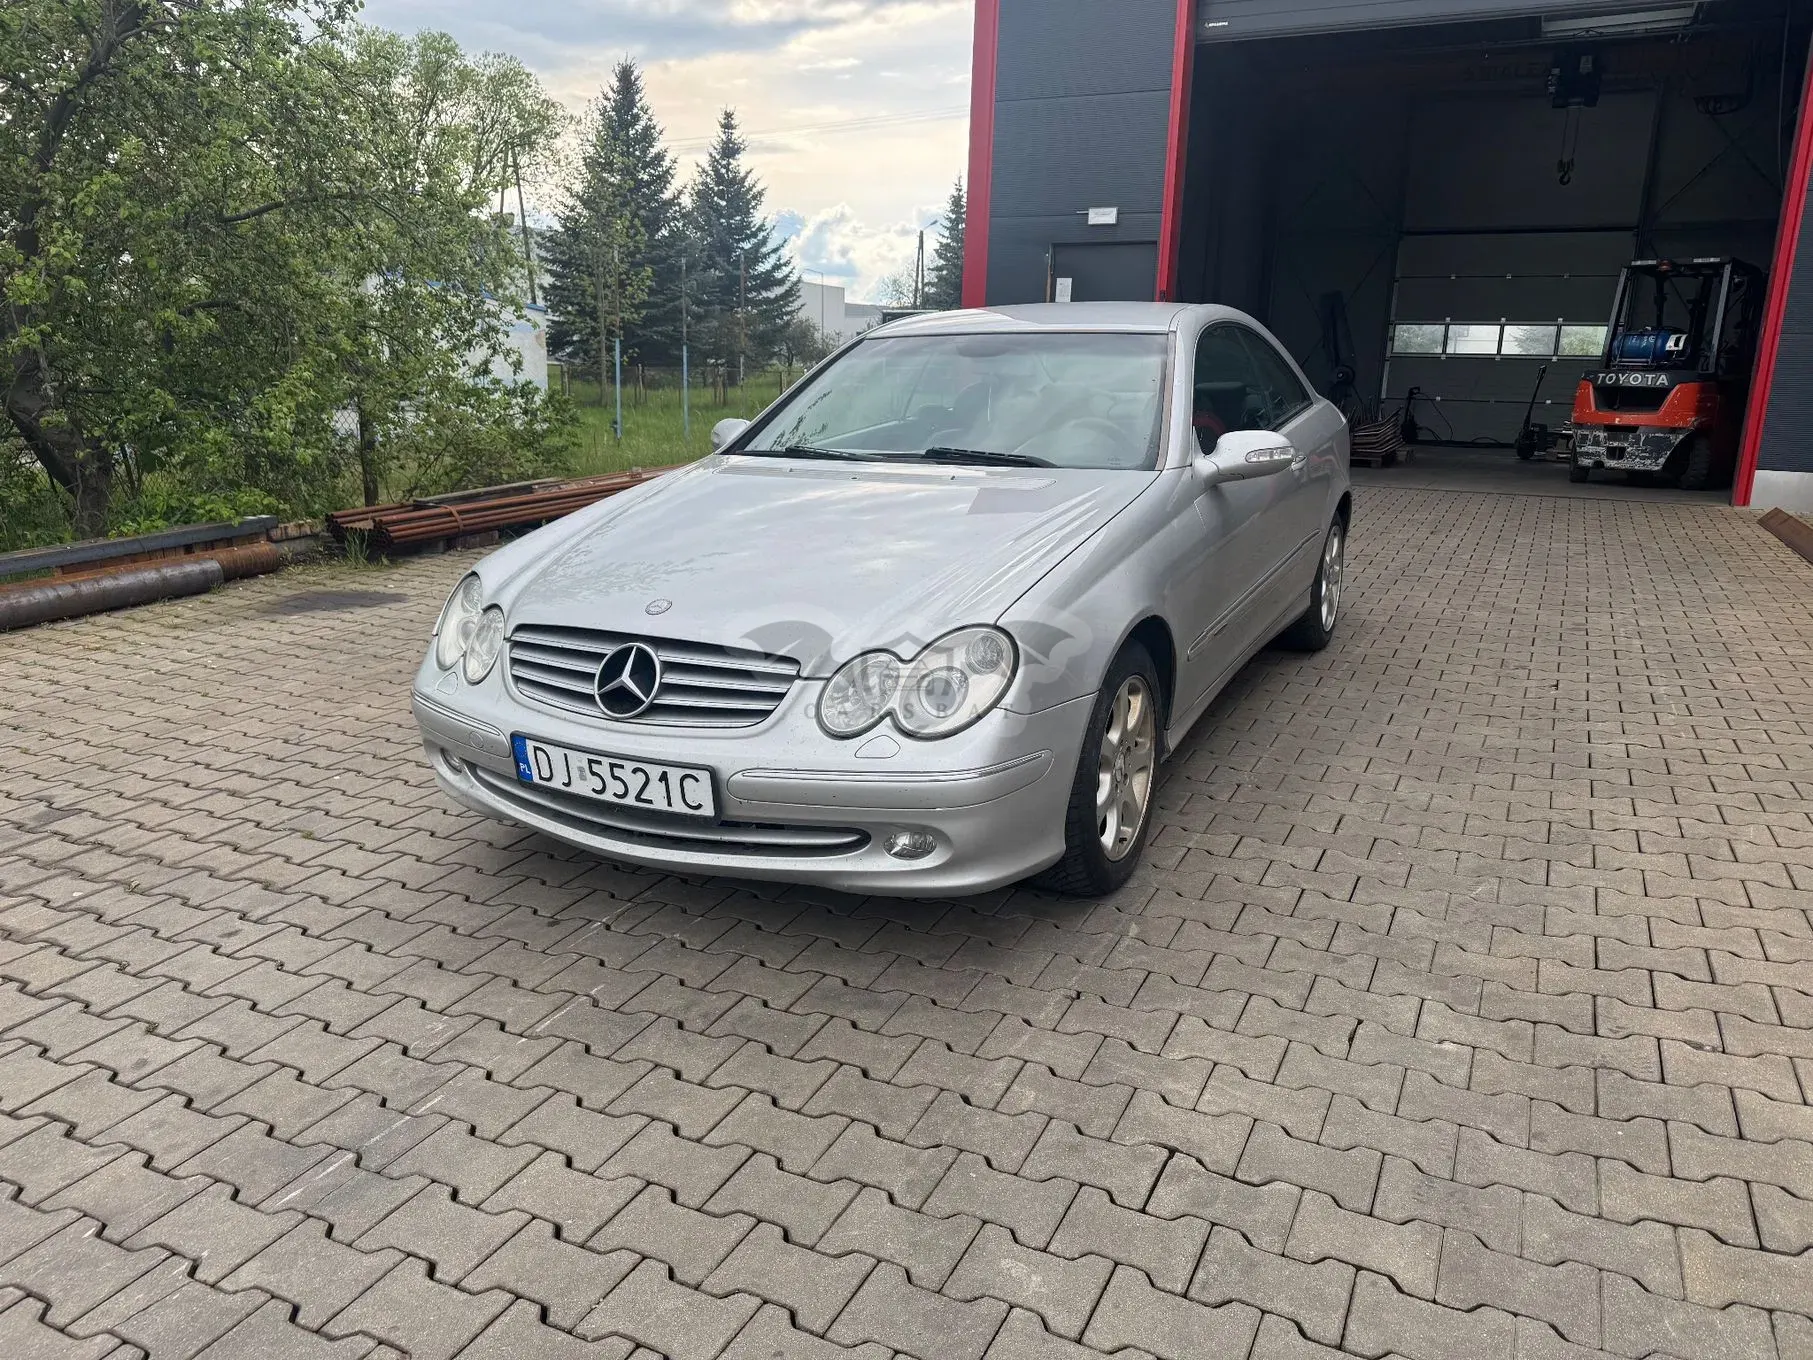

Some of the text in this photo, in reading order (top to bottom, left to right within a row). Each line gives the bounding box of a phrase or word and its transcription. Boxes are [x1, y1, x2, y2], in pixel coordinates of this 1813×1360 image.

[1597, 373, 1669, 386] TOYOTA
[519, 762, 531, 775] PL
[532, 745, 704, 811] DJ 5521C
